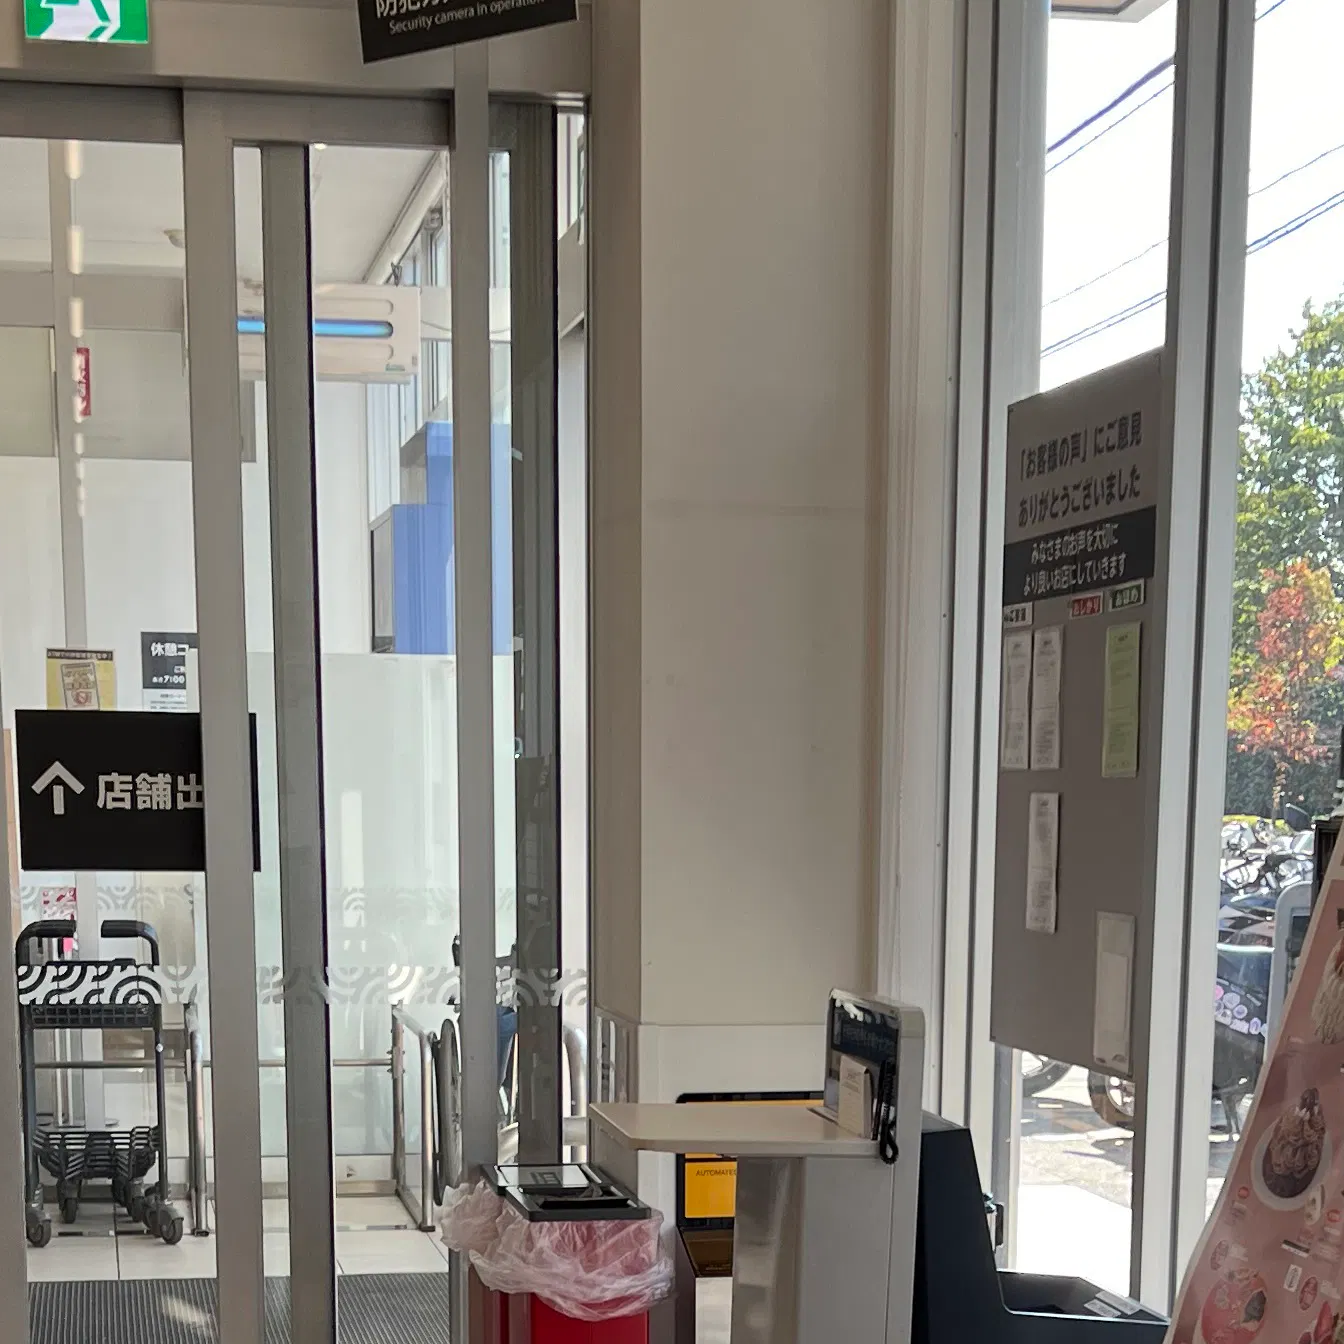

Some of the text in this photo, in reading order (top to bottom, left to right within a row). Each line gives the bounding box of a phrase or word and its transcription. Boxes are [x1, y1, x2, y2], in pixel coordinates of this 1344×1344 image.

[389, 15, 433, 35] Security
[434, 6, 475, 25] camera
[1018, 464, 1141, 528] ありがとうございました
